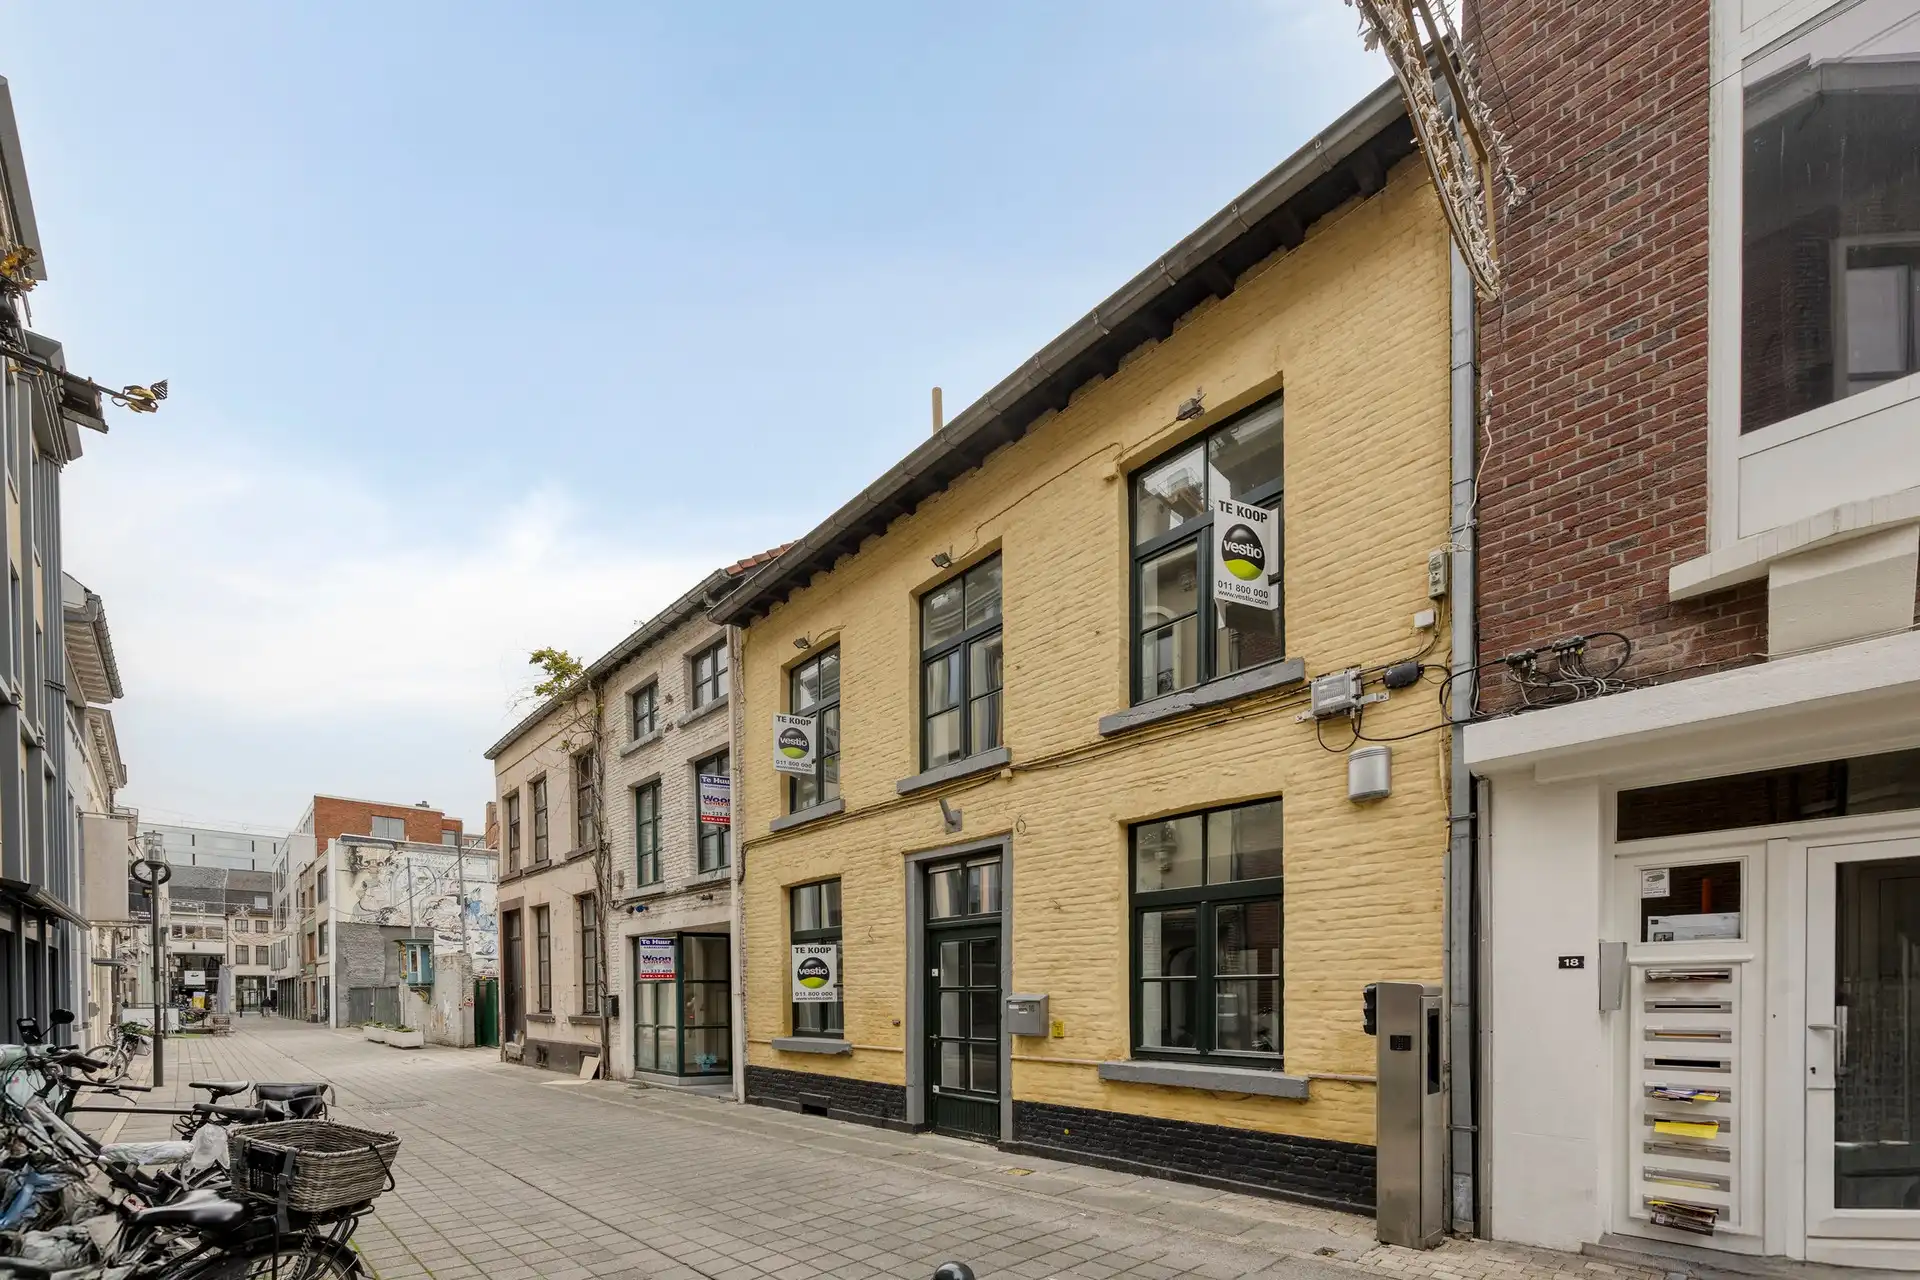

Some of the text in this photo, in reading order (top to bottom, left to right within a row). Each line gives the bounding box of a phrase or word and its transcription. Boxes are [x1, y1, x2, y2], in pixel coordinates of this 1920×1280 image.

[1219, 500, 1268, 523] TE KOOP
[1223, 540, 1263, 559] vestio
[1217, 580, 1269, 599] 011 800 000
[1217, 590, 1269, 606] www.vestio.com
[789, 717, 812, 726] KOOP
[780, 737, 808, 747] vestio
[1563, 958, 1579, 967] 18
[798, 966, 828, 975] vestio
